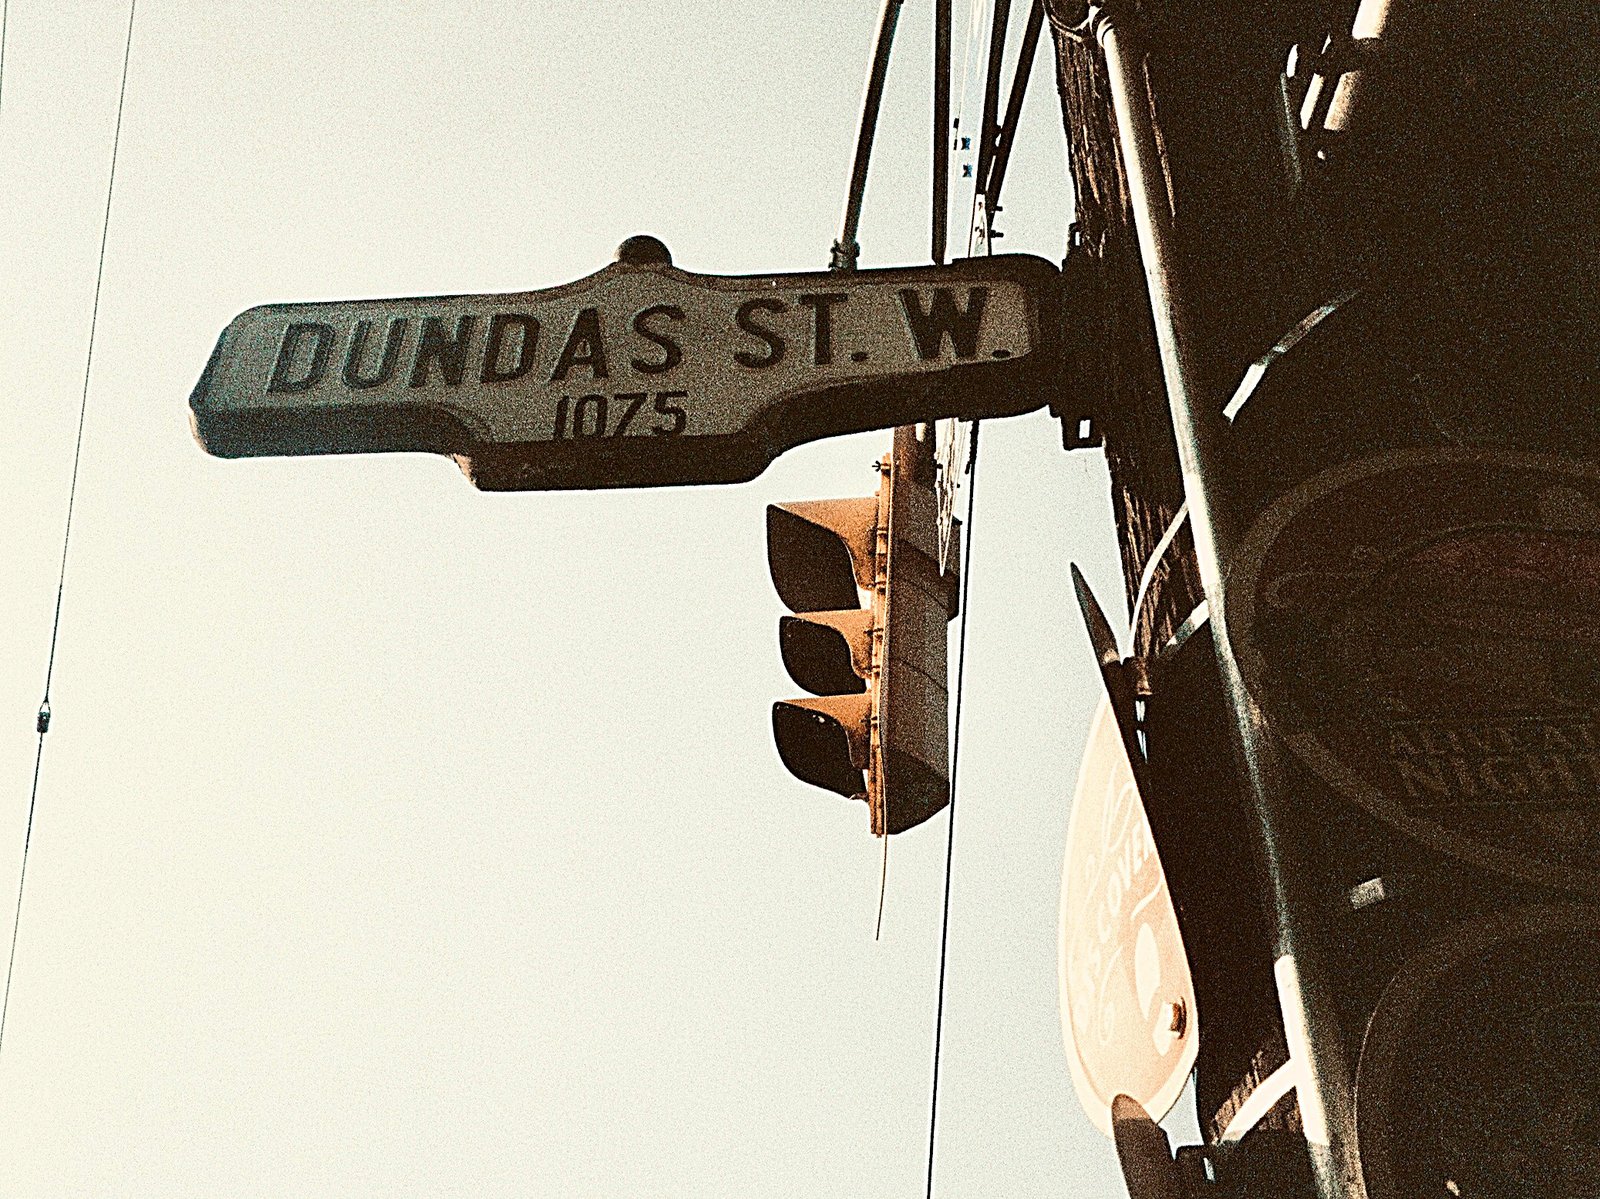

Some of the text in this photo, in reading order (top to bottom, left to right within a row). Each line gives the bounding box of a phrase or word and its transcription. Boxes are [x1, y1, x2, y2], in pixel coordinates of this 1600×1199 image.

[264, 286, 1011, 394] DUNDAS ST. W.
[552, 390, 688, 440] 1075
